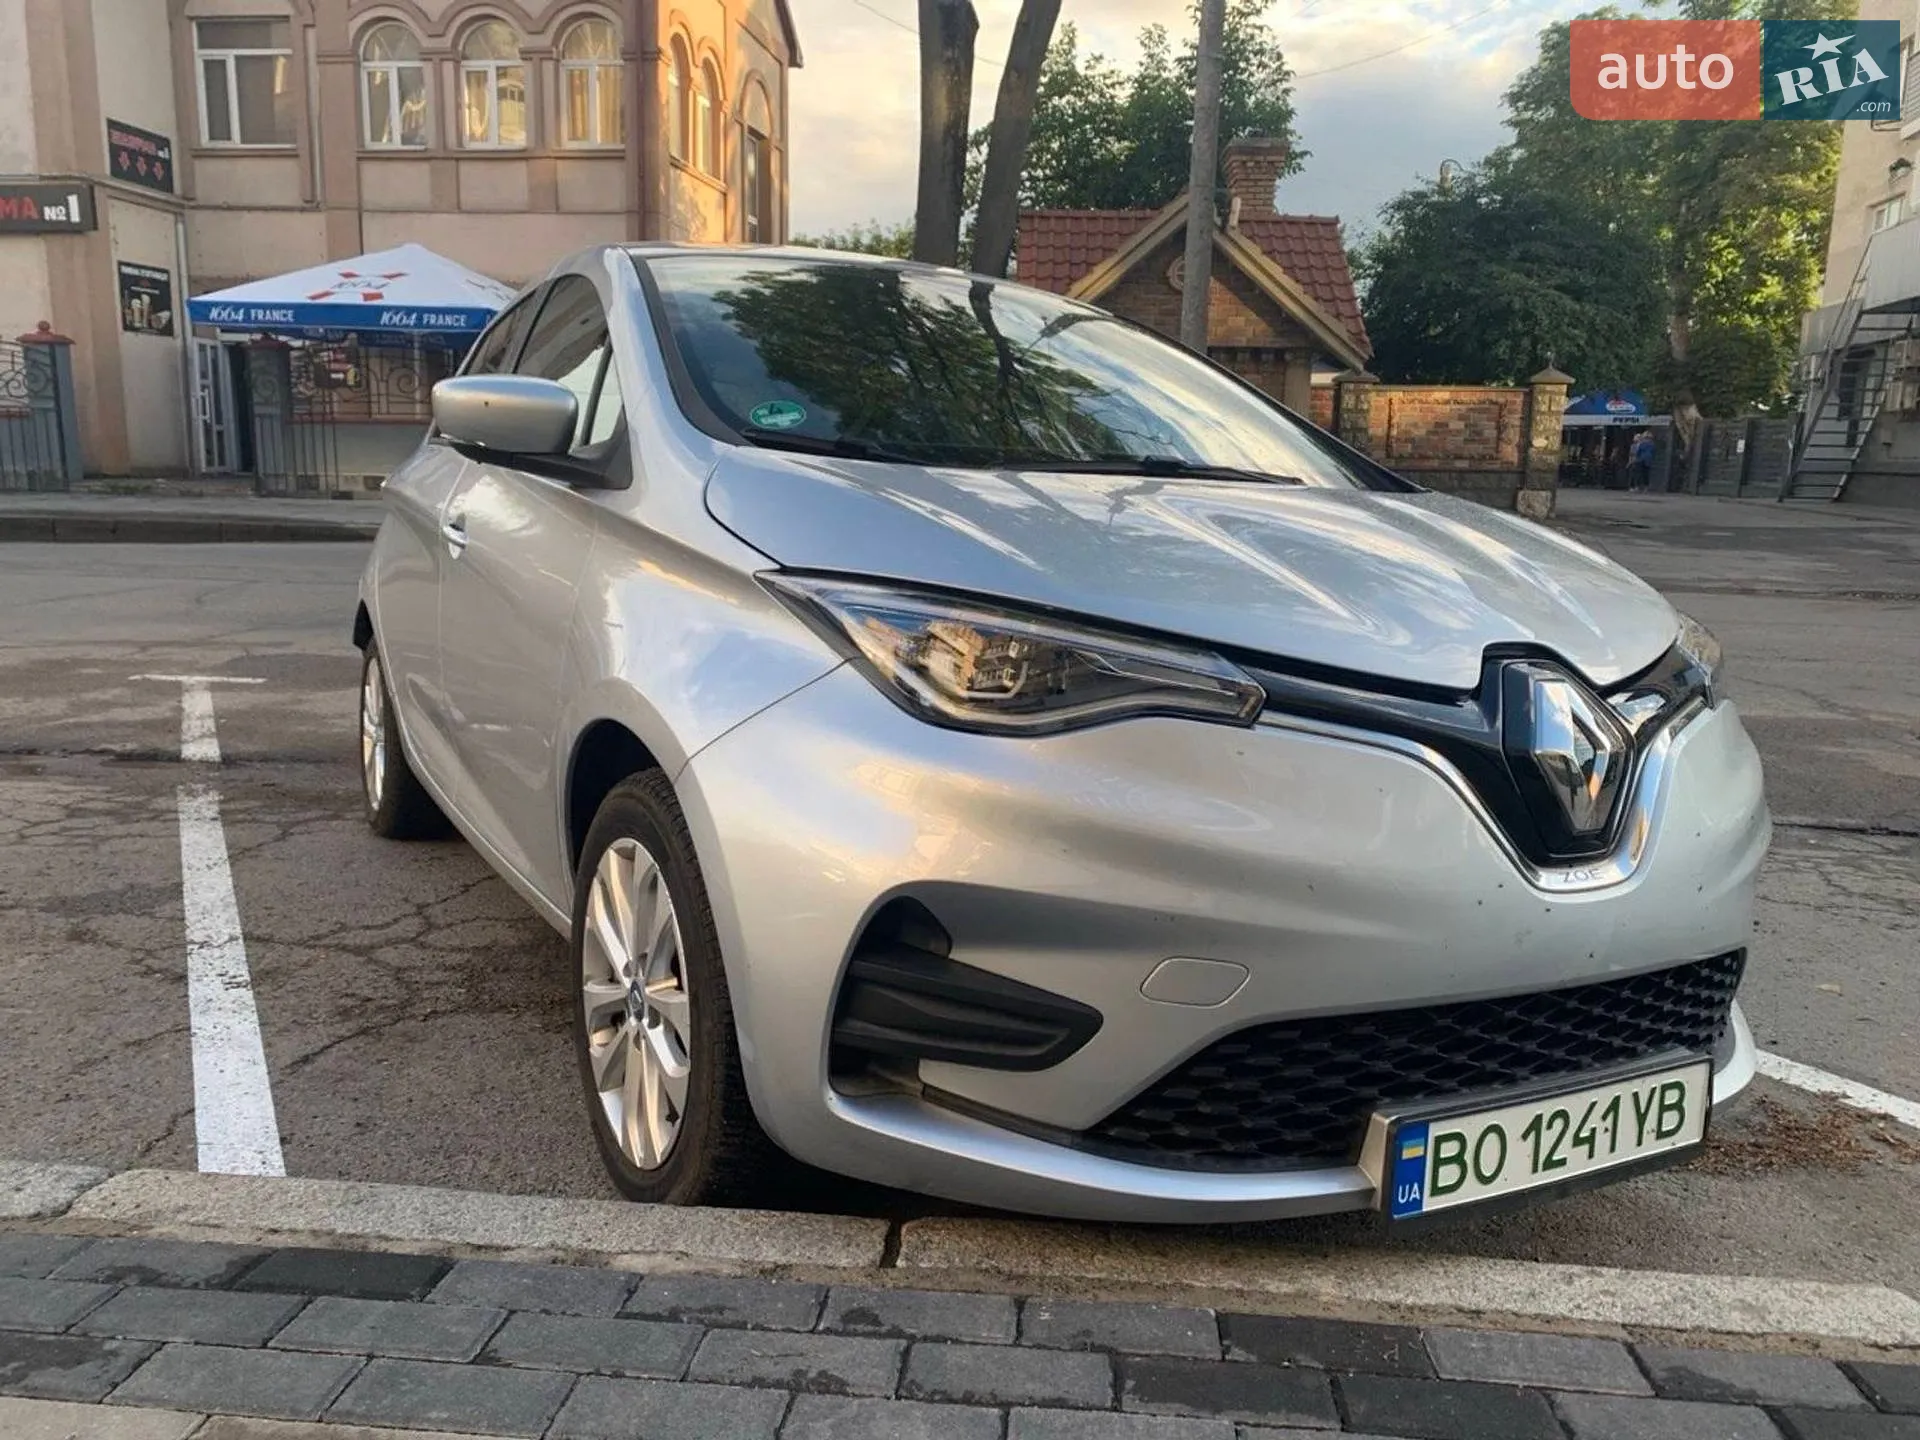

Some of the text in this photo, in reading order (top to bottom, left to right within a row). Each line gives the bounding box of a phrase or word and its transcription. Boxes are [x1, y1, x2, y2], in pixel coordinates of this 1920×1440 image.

[209, 305, 295, 322] 1664 FRANCE
[380, 310, 418, 327] 1664
[422, 313, 468, 327] FRANCE
[1430, 1080, 1686, 1197] BO 1241 YB
[1398, 1182, 1421, 1204] UA
